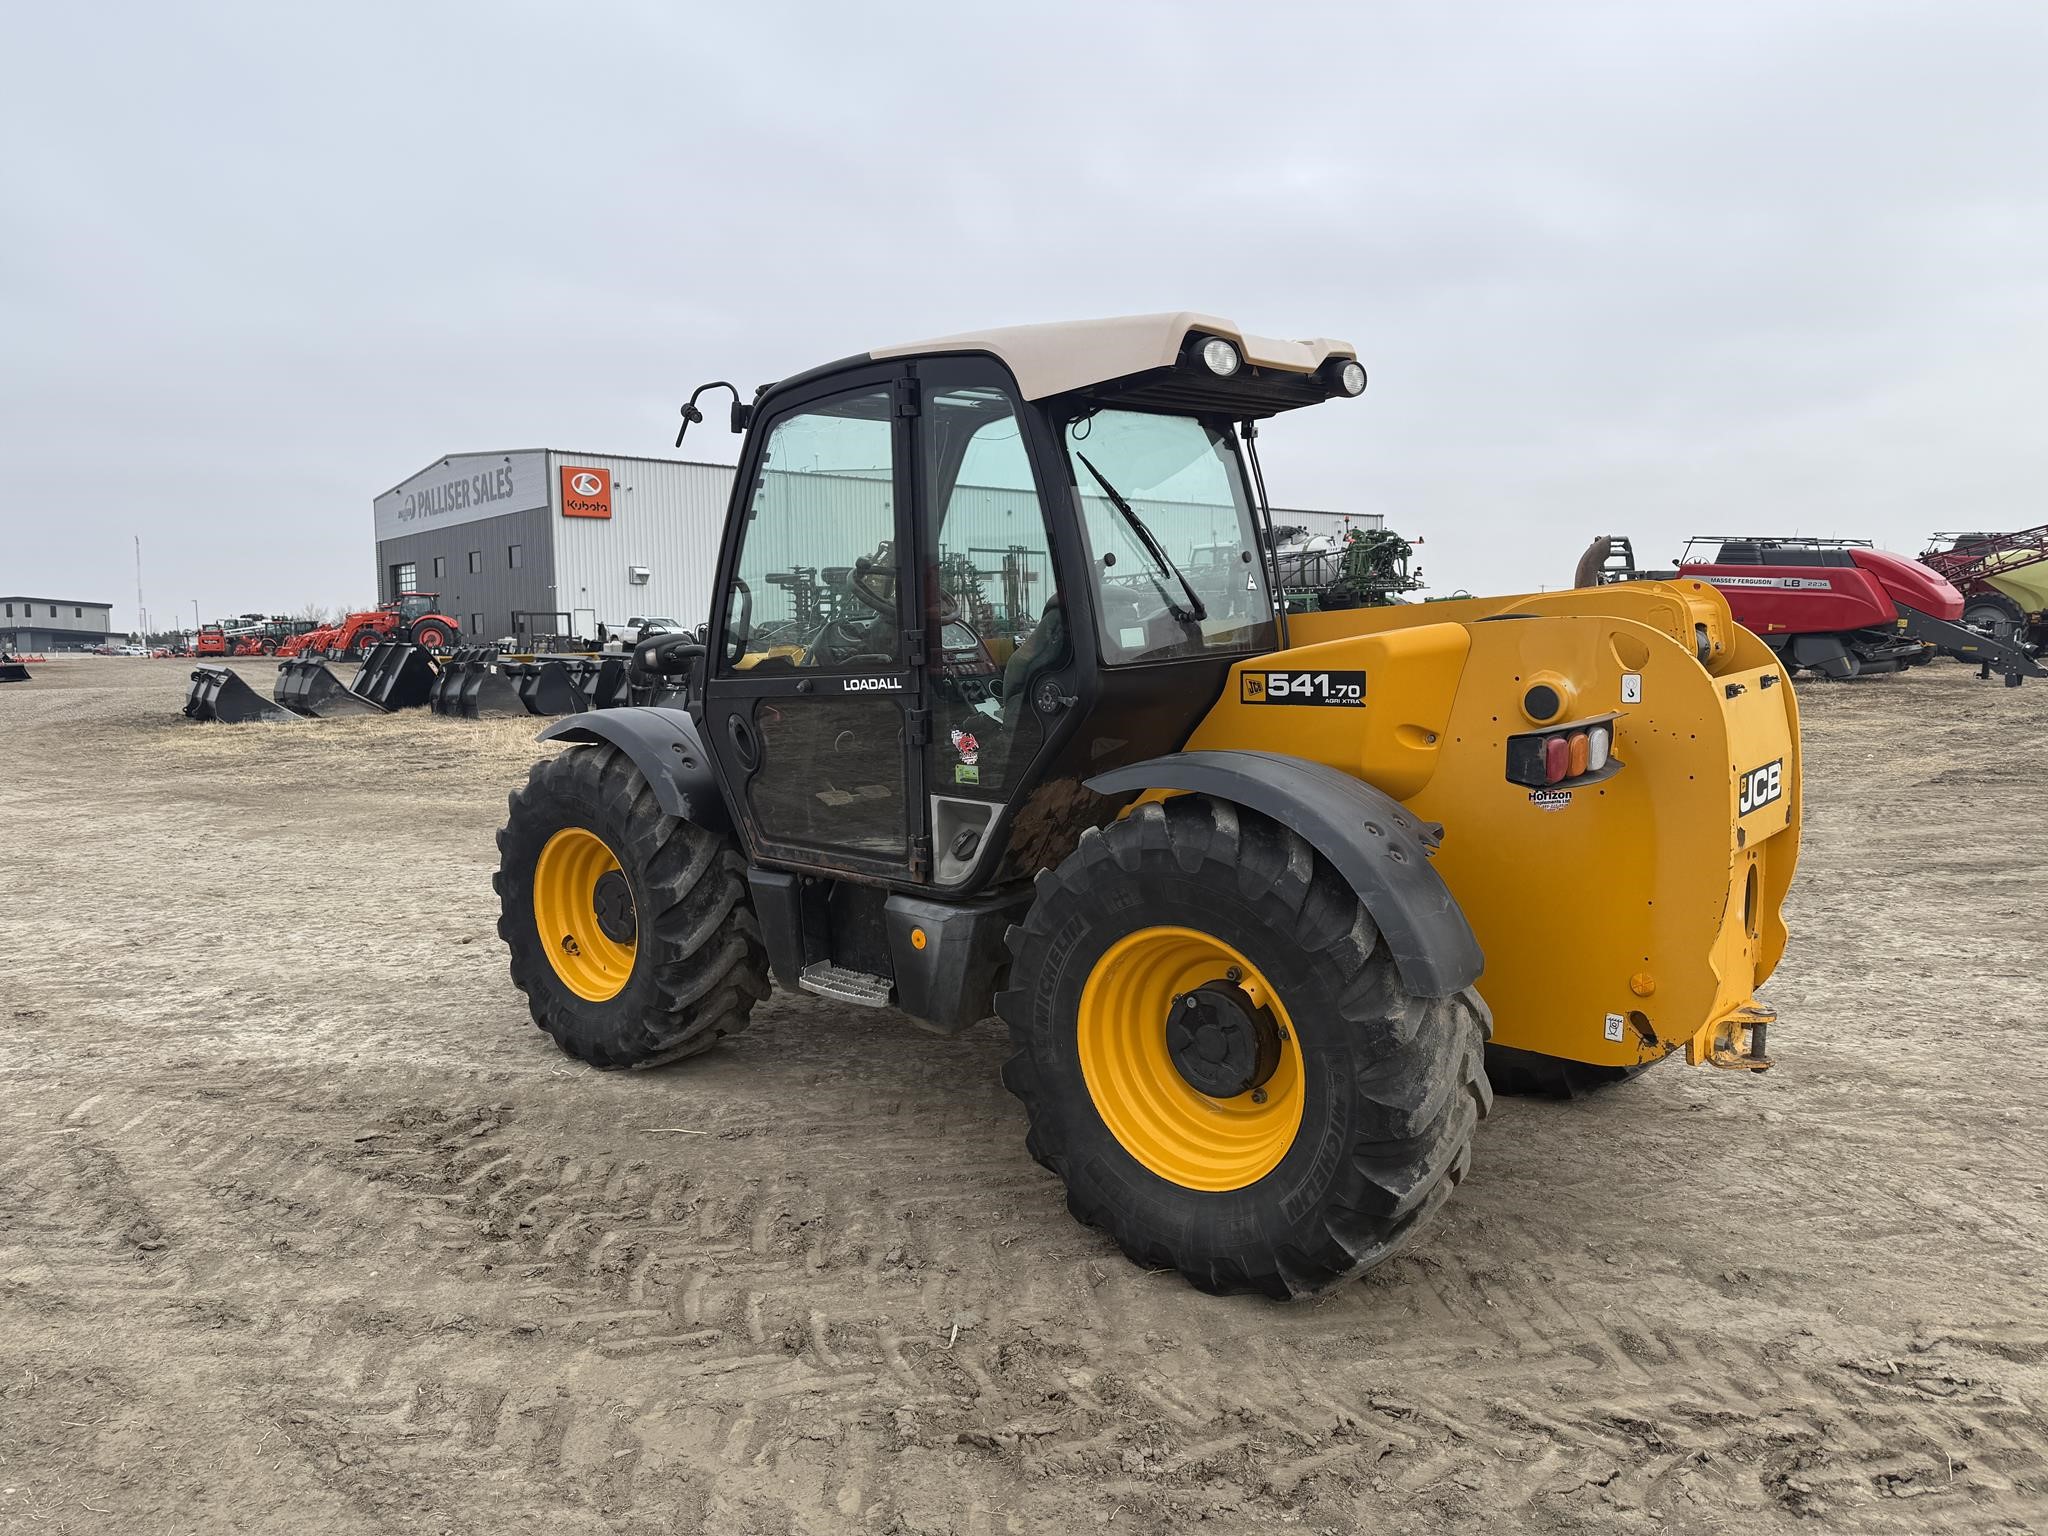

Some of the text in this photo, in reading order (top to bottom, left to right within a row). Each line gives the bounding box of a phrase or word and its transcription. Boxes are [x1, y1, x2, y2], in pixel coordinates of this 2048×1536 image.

[418, 465, 514, 519] PALLISER SALES
[566, 499, 608, 513] Kubota
[1783, 579, 1801, 588] LB
[843, 677, 903, 692] LOADALL
[1267, 673, 1361, 699] 541-70
[1528, 790, 1573, 801] Horizon
[1739, 761, 1783, 814] JCB
[1034, 915, 1088, 1032] MICHELIN
